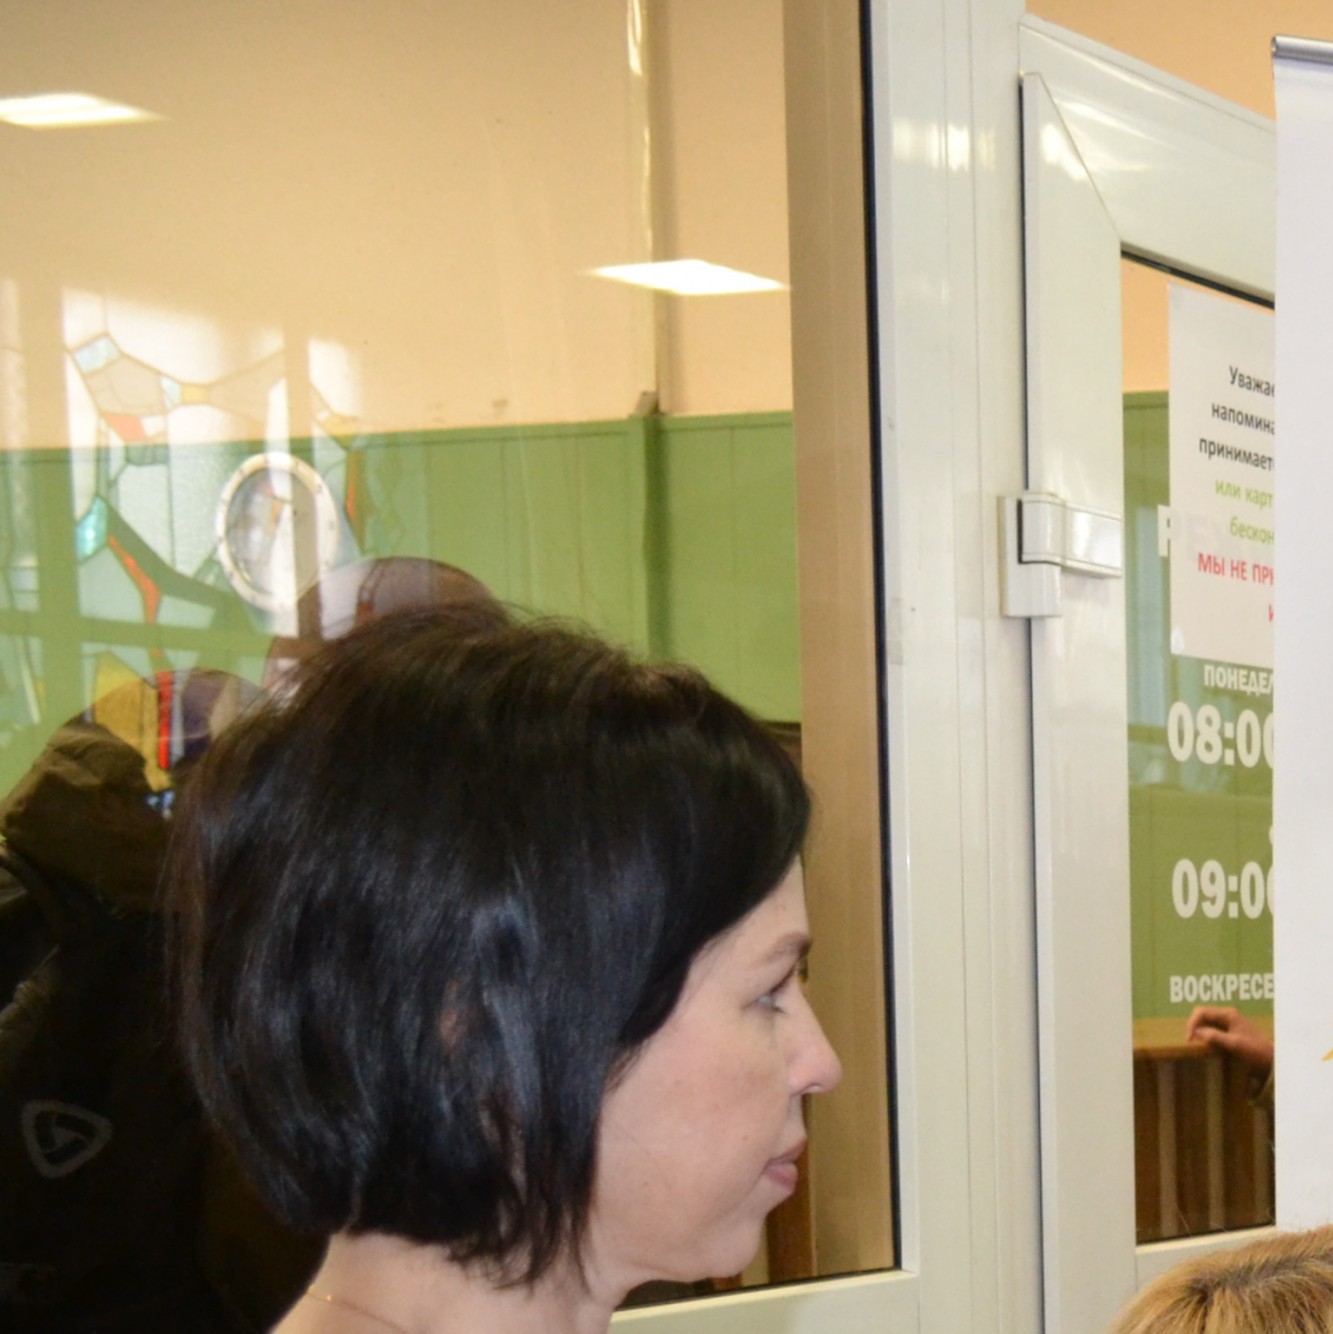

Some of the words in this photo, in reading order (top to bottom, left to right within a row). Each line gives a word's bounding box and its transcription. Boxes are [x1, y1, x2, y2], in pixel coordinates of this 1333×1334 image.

[1199, 438, 1275, 471] принимает
[1246, 488, 1273, 510] карт
[1230, 515, 1275, 545] бескон
[1198, 552, 1225, 577] МЫ
[1230, 558, 1247, 581] НЕ
[1170, 973, 1274, 1003] ВОСКРЕСЕ
